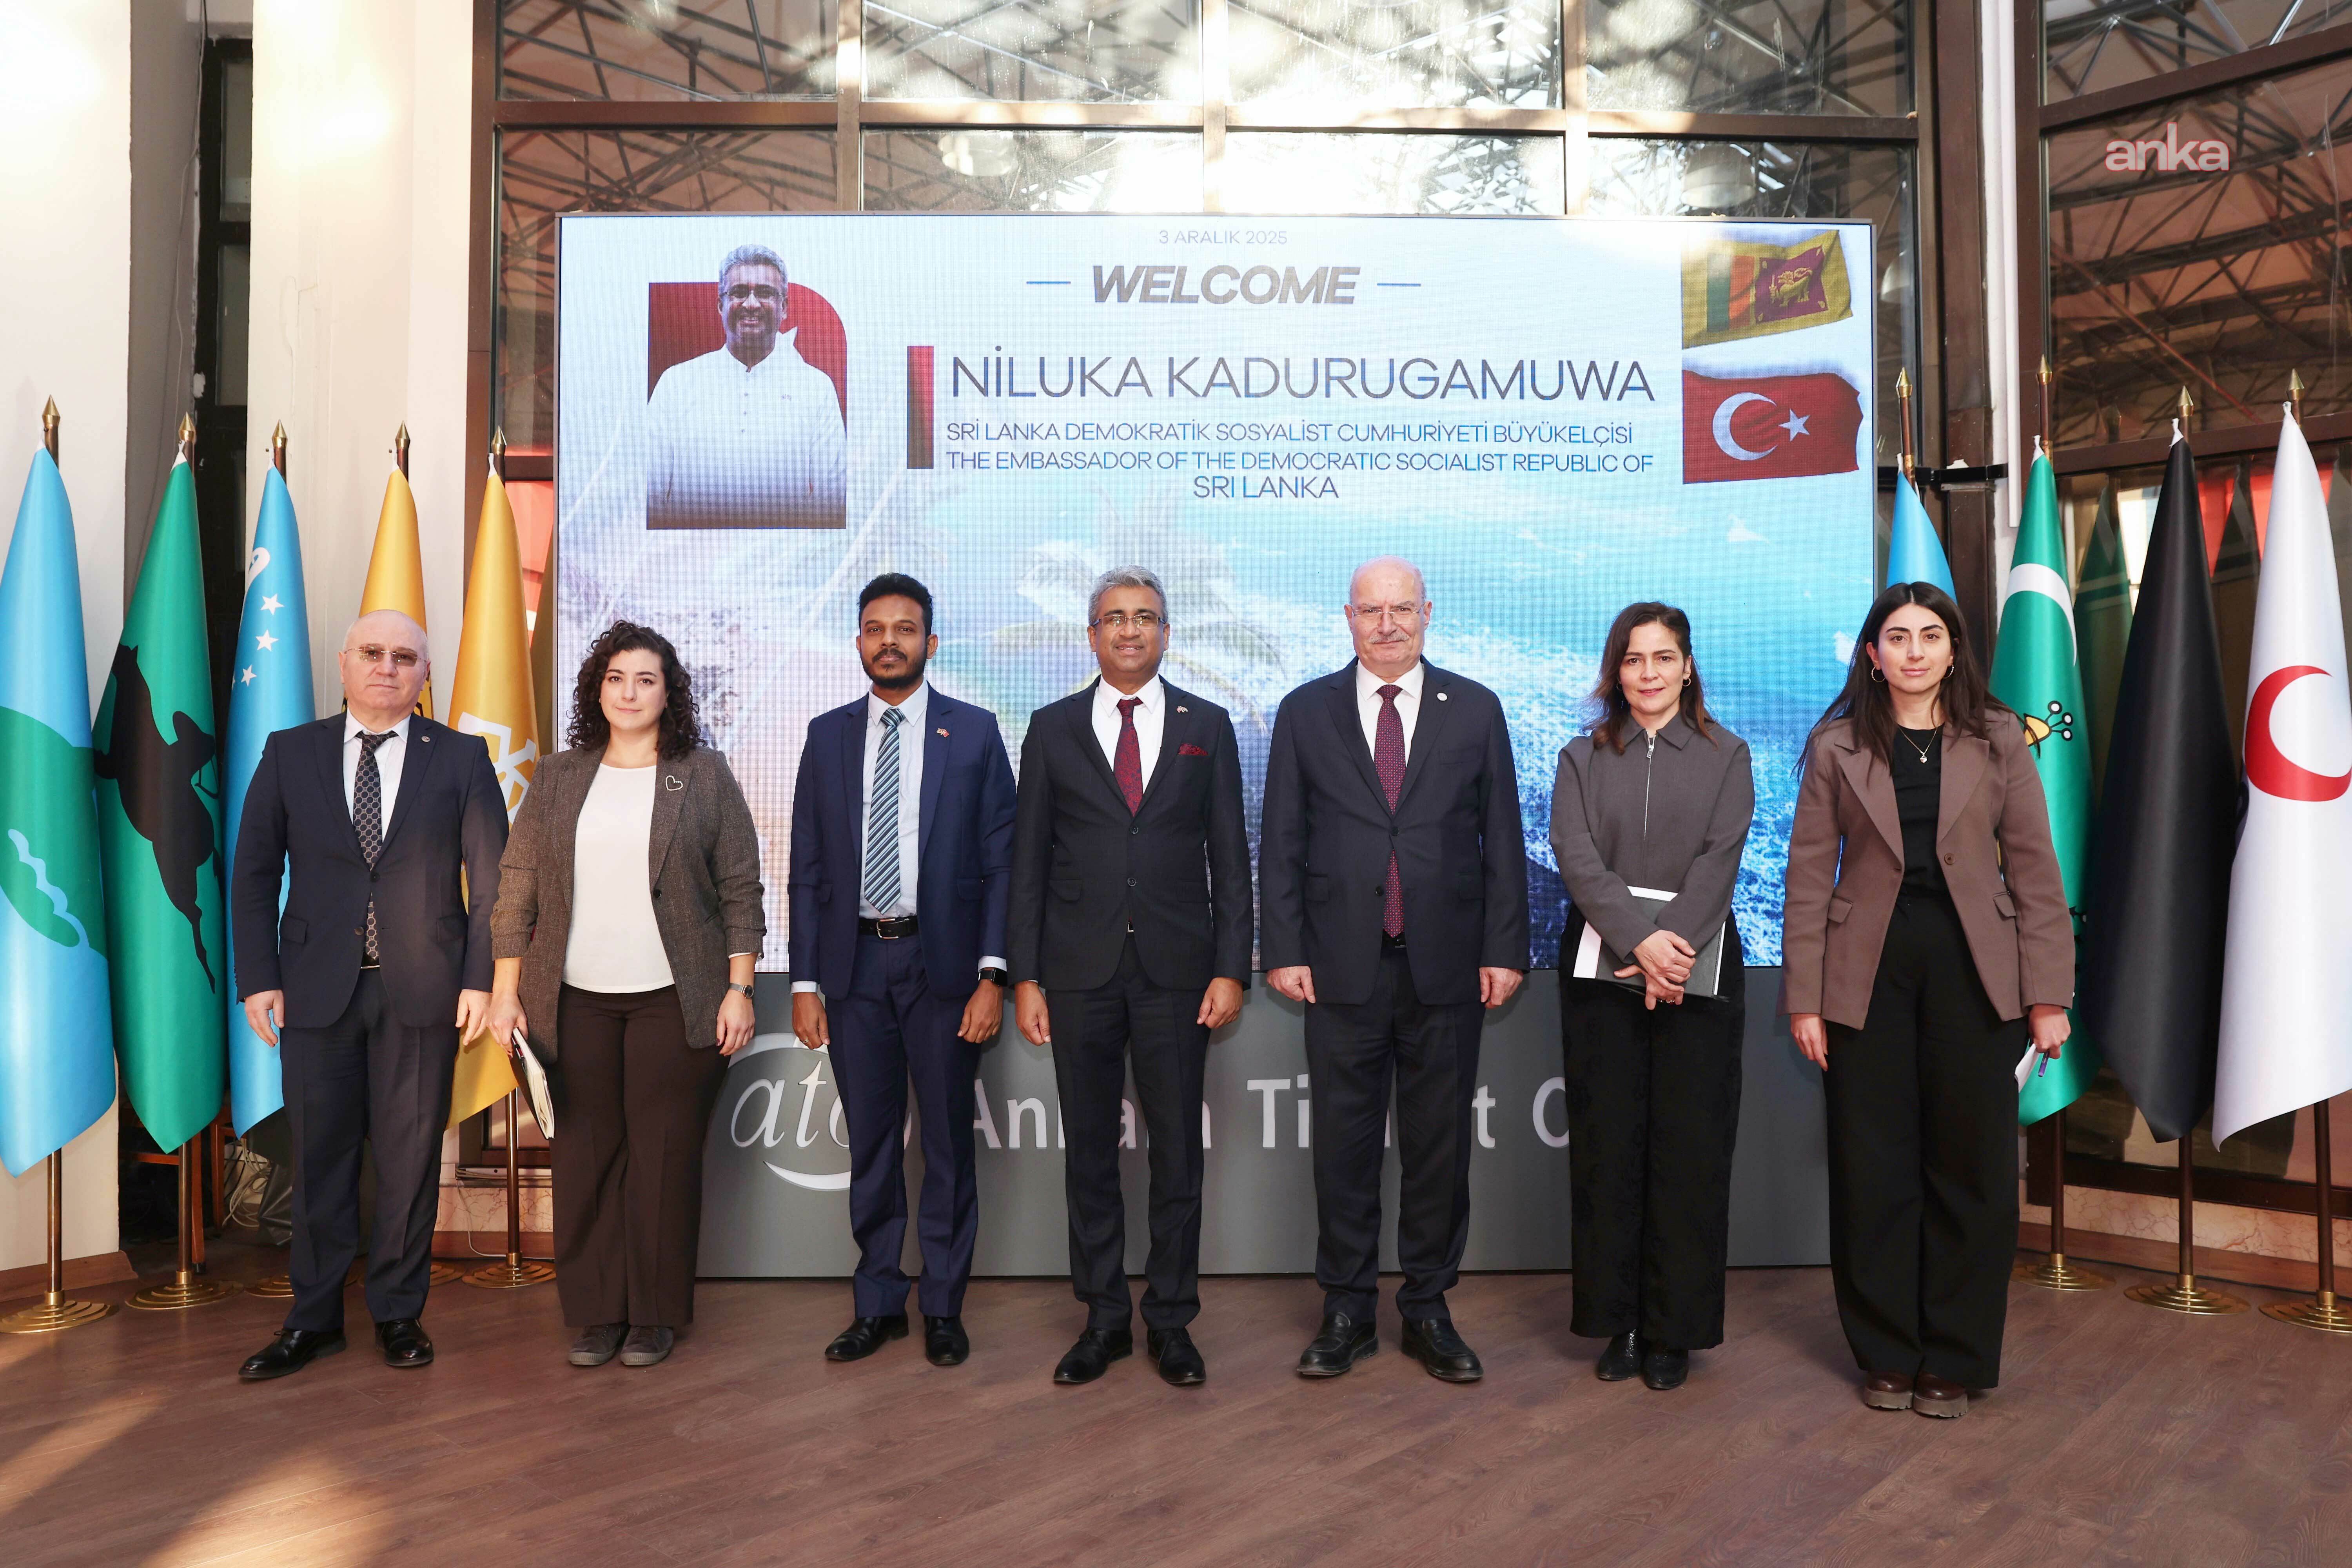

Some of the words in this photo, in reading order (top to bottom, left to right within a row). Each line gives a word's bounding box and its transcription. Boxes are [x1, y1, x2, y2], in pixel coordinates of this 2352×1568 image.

[1159, 230, 1169, 244] 3
[1174, 230, 1240, 244] ARALIK
[1246, 231, 1287, 245] 2025
[1093, 265, 1361, 304] WELCOME
[953, 345, 1153, 397] NİLUKA
[1168, 356, 1655, 401] KADURUGAMUWA
[947, 419, 979, 440] SRİ
[985, 423, 1060, 440] LANKA
[1065, 419, 1210, 441] DEMOKRATİK
[1216, 419, 1333, 441] SOSYALİST
[1337, 420, 1488, 443] CUMHURİYETİ
[1494, 421, 1633, 447] BÜYÜKELÇİSİ
[947, 452, 990, 470] THE
[996, 452, 1152, 470] EMBASSADOR
[1156, 452, 1188, 470] OF
[1192, 452, 1235, 470] THE
[1241, 452, 1391, 470] DEMOCRATIC
[1396, 453, 1508, 472] SOCIALIST
[1512, 453, 1618, 472] REPUBLIC
[1623, 454, 1654, 472] OF
[1193, 476, 1235, 498] SRI
[1242, 476, 1339, 498] LANKA
